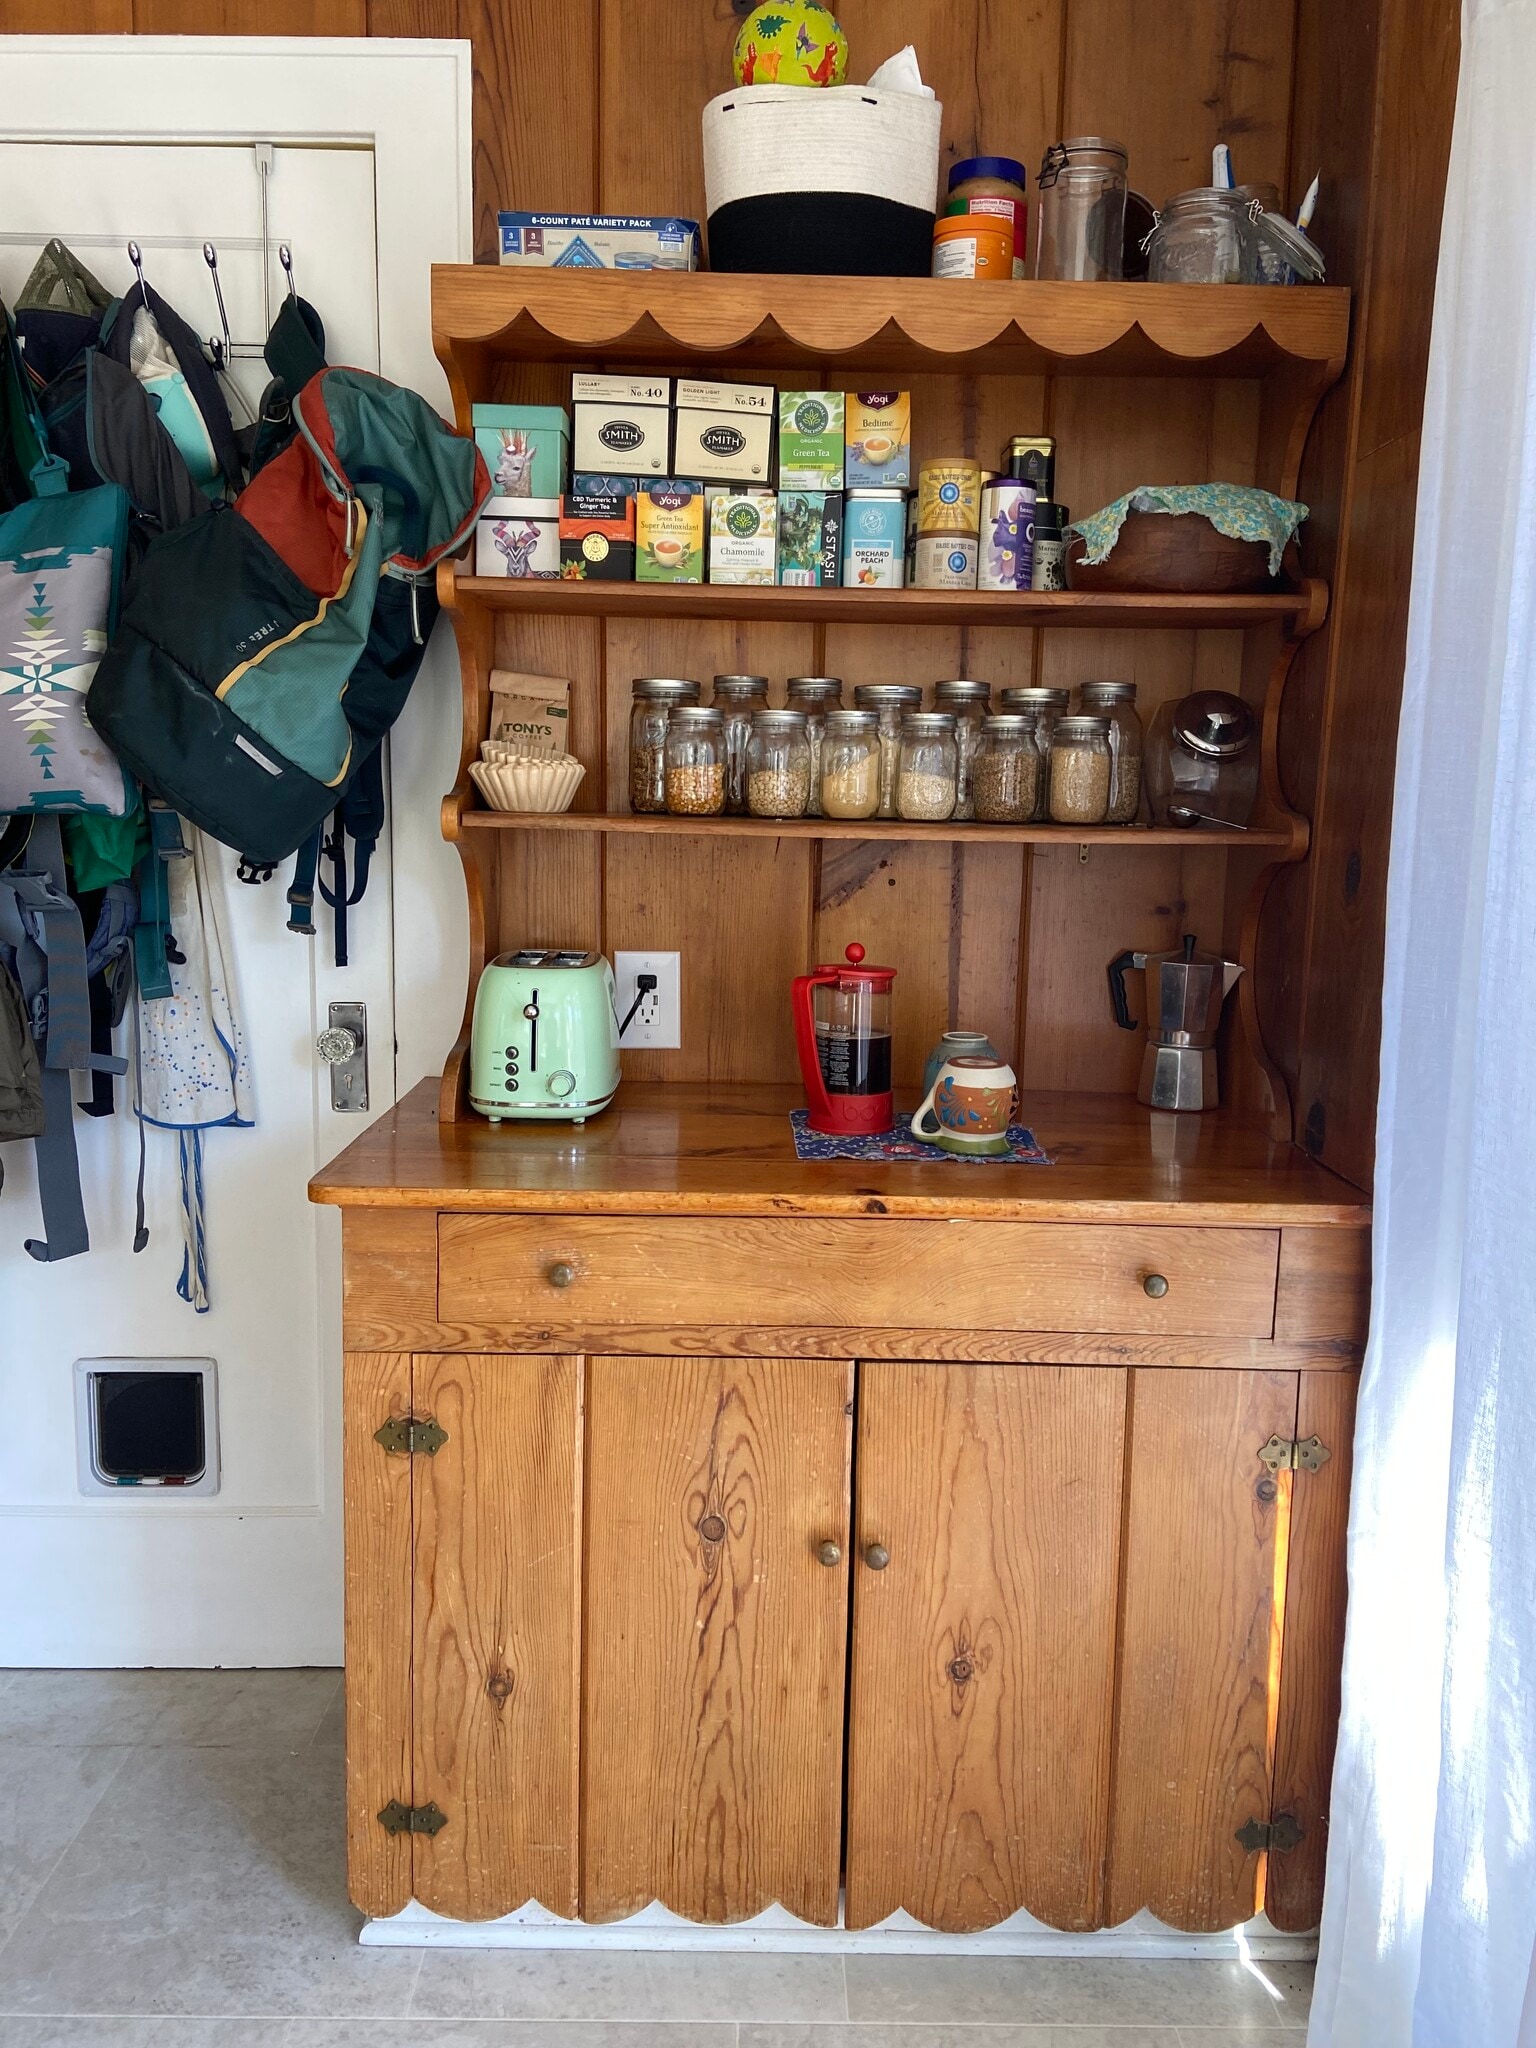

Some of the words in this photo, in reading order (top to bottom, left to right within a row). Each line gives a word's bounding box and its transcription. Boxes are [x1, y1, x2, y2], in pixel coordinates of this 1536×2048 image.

[571, 216, 590, 226] PATÉ
[592, 218, 626, 227] VARIETY
[630, 219, 651, 227] PACK
[631, 388, 644, 397] No.
[646, 388, 663, 398] 40
[749, 396, 767, 407] 54
[798, 402, 825, 416] TRADITIONAL
[862, 419, 893, 428] Bedtime
[605, 430, 638, 441] SMITH
[706, 435, 739, 446] SMITH
[729, 505, 757, 519] TRADITIONAL
[640, 521, 659, 530] Super
[661, 522, 699, 531] Antioxidant
[730, 524, 757, 536] MEDICINALS
[720, 547, 764, 556] Chamomile
[824, 536, 836, 578] STASH
[249, 623, 275, 641] TREE
[503, 723, 552, 736] TONYS
